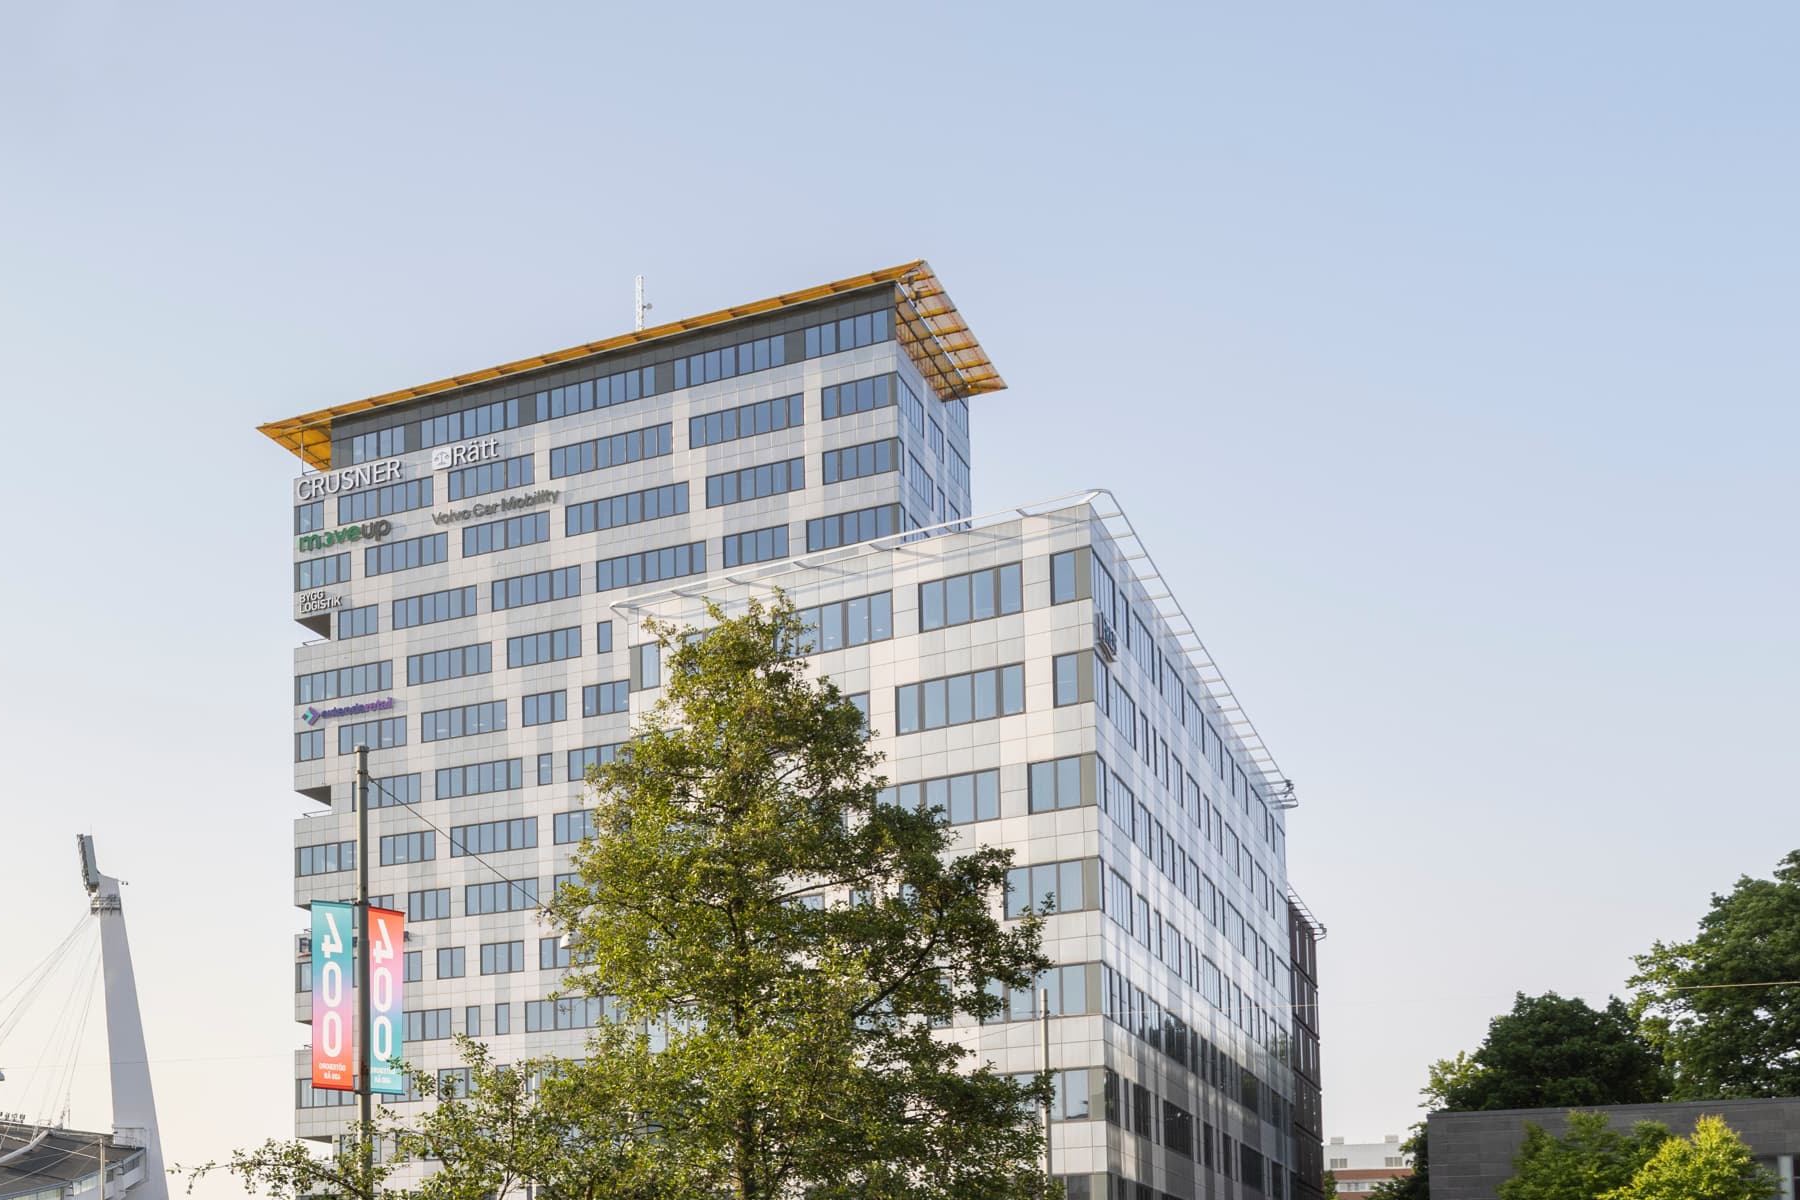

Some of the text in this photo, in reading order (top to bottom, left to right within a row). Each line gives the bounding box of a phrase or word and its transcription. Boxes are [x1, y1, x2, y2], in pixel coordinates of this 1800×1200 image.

[452, 437, 501, 466] Rätt
[296, 459, 403, 500] CRUSNER
[432, 489, 561, 525] Volvo Car Mobility
[299, 591, 325, 603] BYGG
[299, 595, 343, 613] LOGISTIK
